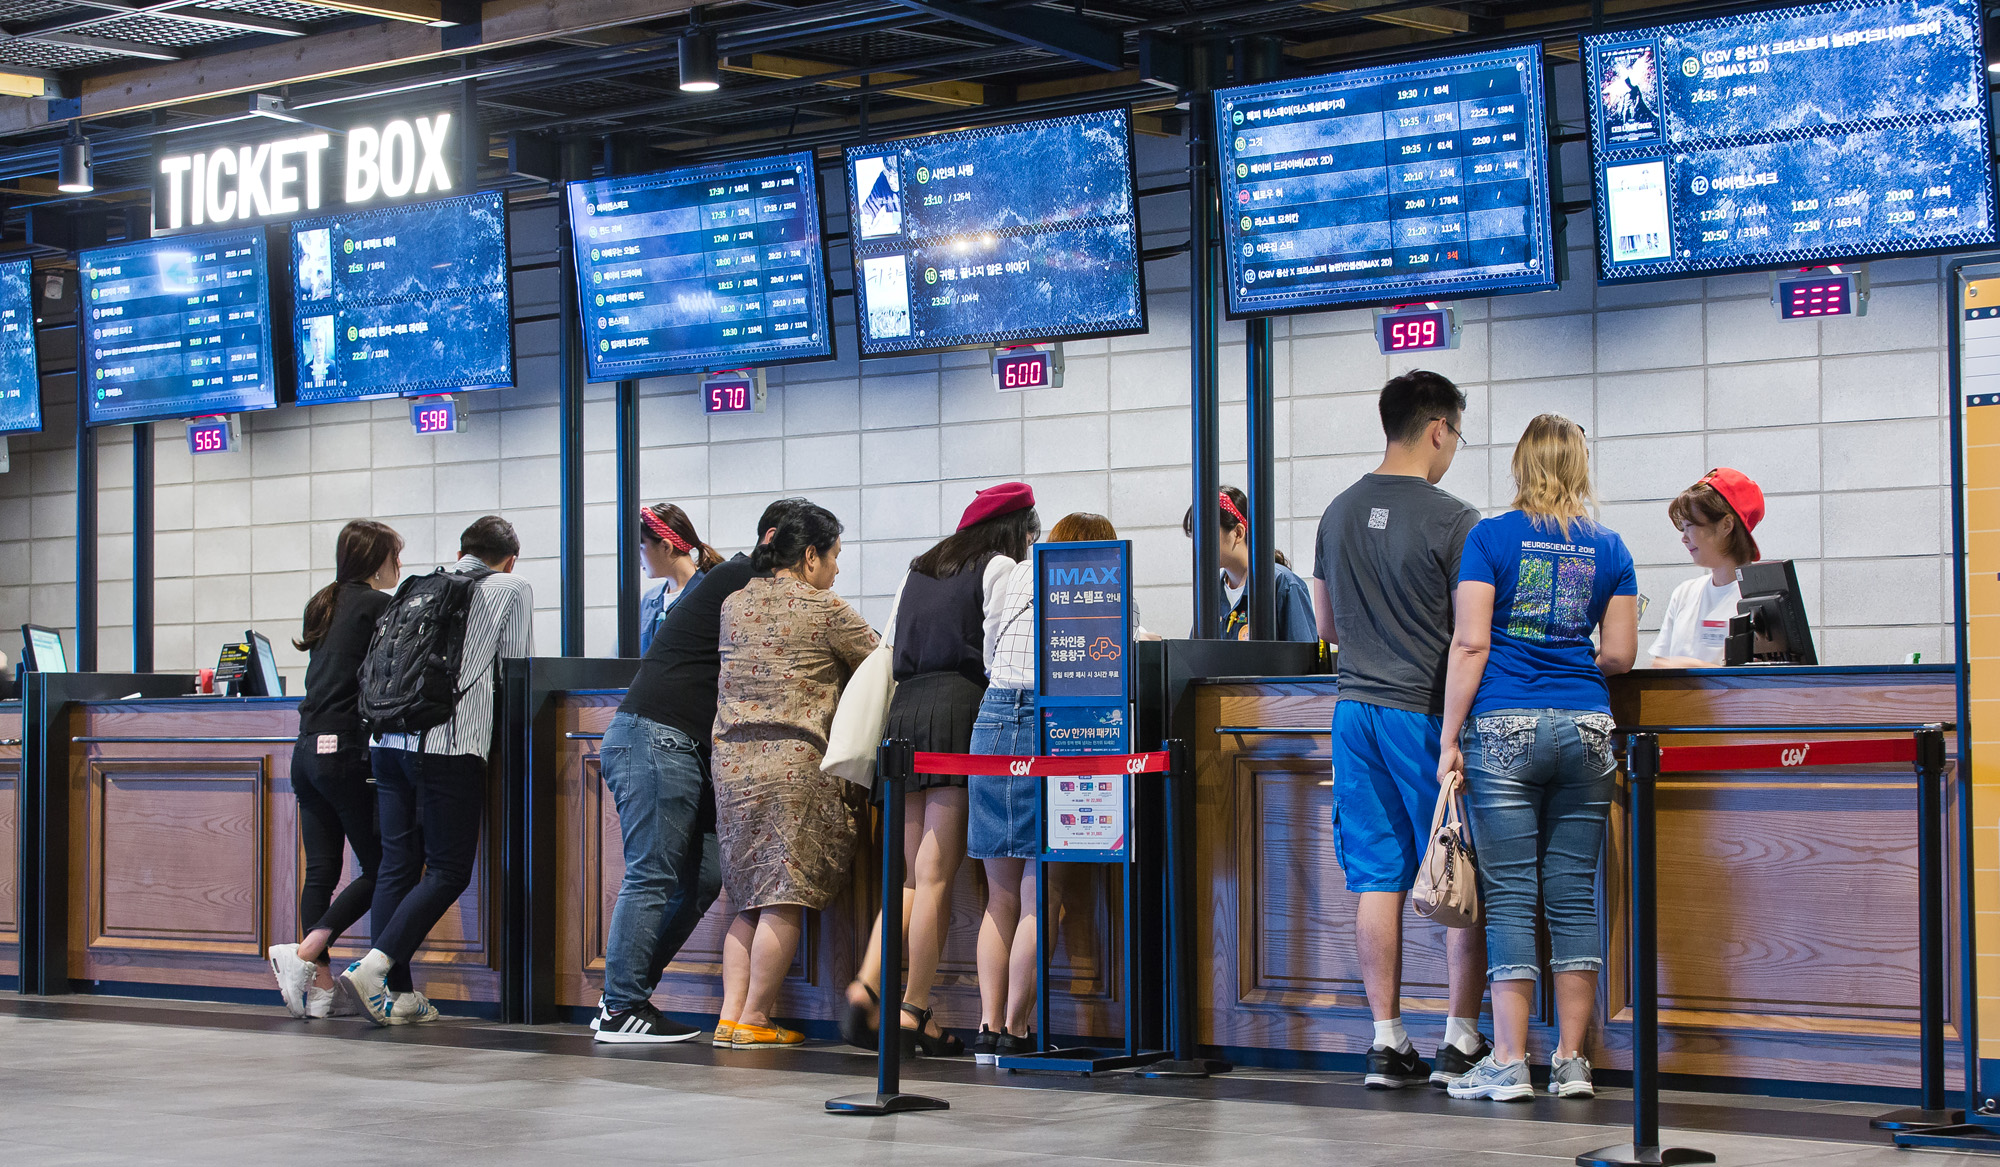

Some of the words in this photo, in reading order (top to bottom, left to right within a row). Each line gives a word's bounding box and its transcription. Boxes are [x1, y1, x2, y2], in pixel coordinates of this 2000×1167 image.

[1702, 50, 1731, 66] (CGV
[1734, 46, 1757, 61] 용산
[1761, 45, 1770, 56] X
[1750, 59, 1769, 73] 2D)
[1398, 90, 1417, 100] 19:30
[1471, 108, 1488, 117] 22:25
[1400, 117, 1419, 127] 19:35
[1249, 137, 1262, 147] 그것
[1472, 136, 1490, 145] 22:00
[1402, 144, 1421, 154] 19:35
[1251, 161, 1271, 174] 베이비
[1320, 154, 1333, 166] 2D)
[1474, 164, 1492, 173] 20:10
[161, 133, 329, 229] TICKET
[346, 114, 451, 203] BOX
[932, 166, 955, 180] 시인의
[957, 164, 974, 176] 사랑
[1404, 172, 1423, 182] 20:10
[709, 187, 724, 196] 17:30
[762, 180, 775, 189] 18:20
[1712, 172, 1779, 191] 아이캔스피크
[924, 195, 942, 206] 23:10
[953, 191, 971, 202] 126석
[1405, 199, 1425, 209] 20:40
[1700, 209, 1727, 222] 17:30
[1742, 204, 1767, 218] 141석
[1791, 199, 1818, 212] 18:20
[1885, 189, 1914, 202] 20:00
[712, 211, 726, 219] 17:35
[1255, 216, 1276, 227] 라스트
[1408, 227, 1427, 236] 21:20
[1702, 229, 1729, 242] 20:50
[1744, 225, 1768, 237] 310석
[1793, 221, 1820, 233] 22:30
[1887, 210, 1916, 223] 23:20
[714, 234, 728, 243] 17:40
[1257, 243, 1277, 253] 이웃집
[1279, 241, 1293, 251] 스타
[716, 258, 730, 266] 18:00
[768, 252, 781, 260] 20:25
[1409, 254, 1429, 264] 21:30
[961, 266, 984, 279] 끝나지
[987, 263, 1003, 276] 않은
[1005, 260, 1030, 274] 이야기
[1258, 269, 1274, 280] (CGV
[1381, 257, 1392, 268] 2D)
[718, 281, 733, 290] 18:15
[932, 296, 950, 307] 23:30
[721, 305, 735, 313] 18:20
[723, 328, 737, 337] 18:30
[775, 323, 788, 331] 21:10
[1392, 319, 1436, 349] 599
[1005, 361, 1042, 386] 600
[712, 387, 745, 411] 570
[420, 409, 448, 432] 598
[195, 429, 221, 450] 565
[1522, 541, 1575, 551] NEUROSCIENCE
[1578, 546, 1595, 554] 2016
[1049, 567, 1119, 585] IMAX
[1050, 591, 1069, 604] 여권
[1073, 590, 1104, 603] 스탬프
[1106, 593, 1121, 602] 안내
[1050, 636, 1085, 648] 주차인증
[1101, 641, 1108, 653] P
[1051, 650, 1086, 661] 전용창구
[1050, 729, 1070, 738] CGV
[1072, 728, 1095, 738] 한가위
[1097, 728, 1119, 738] 패키지
[1781, 749, 1807, 766] CGV
[1010, 761, 1031, 775] CGV
[1127, 759, 1146, 773] CGV
